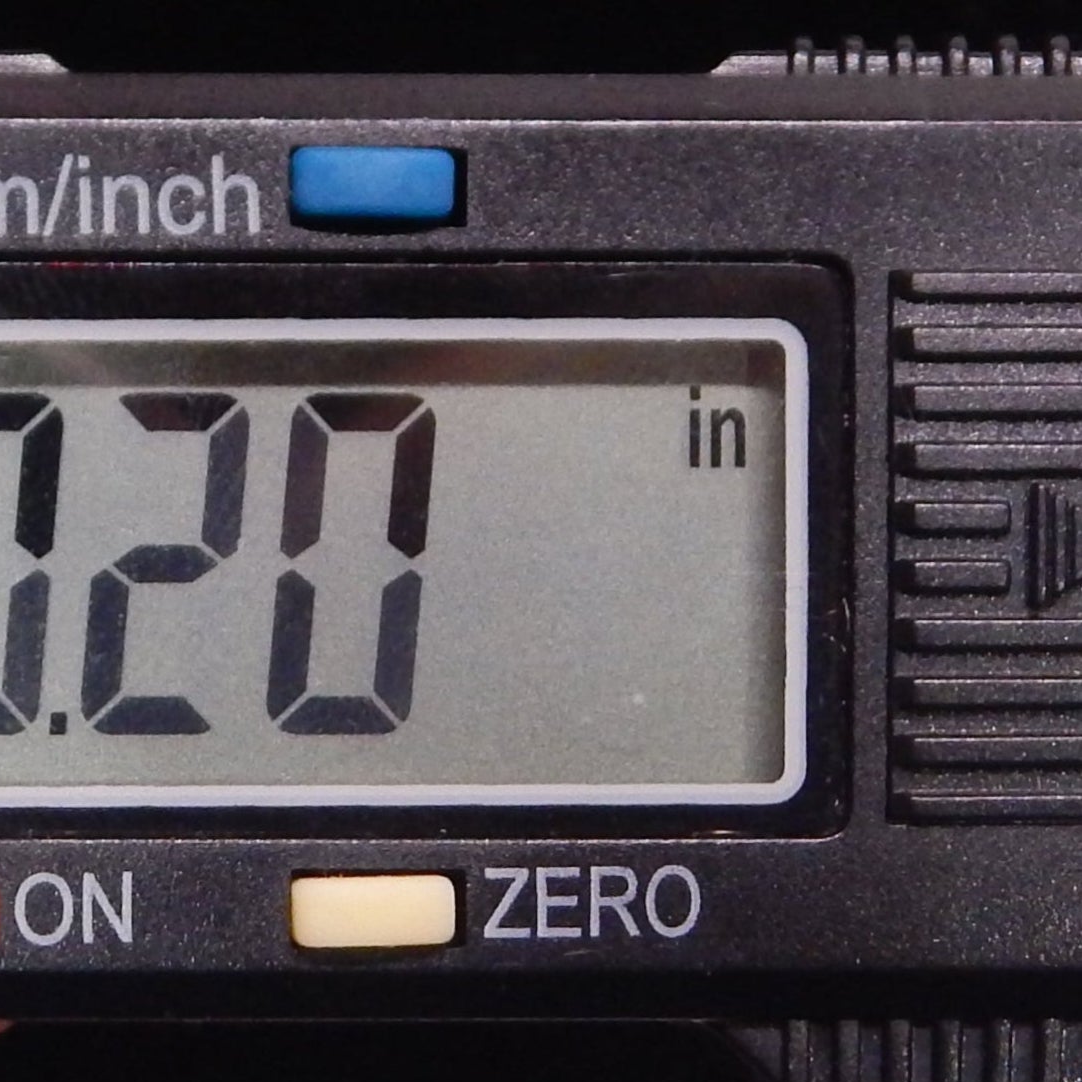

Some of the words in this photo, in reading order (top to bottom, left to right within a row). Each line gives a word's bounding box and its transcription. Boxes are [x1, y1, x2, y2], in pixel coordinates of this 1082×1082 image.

[688, 386, 747, 468] in
[13, 868, 135, 946] ON
[483, 864, 703, 941] ZERO
